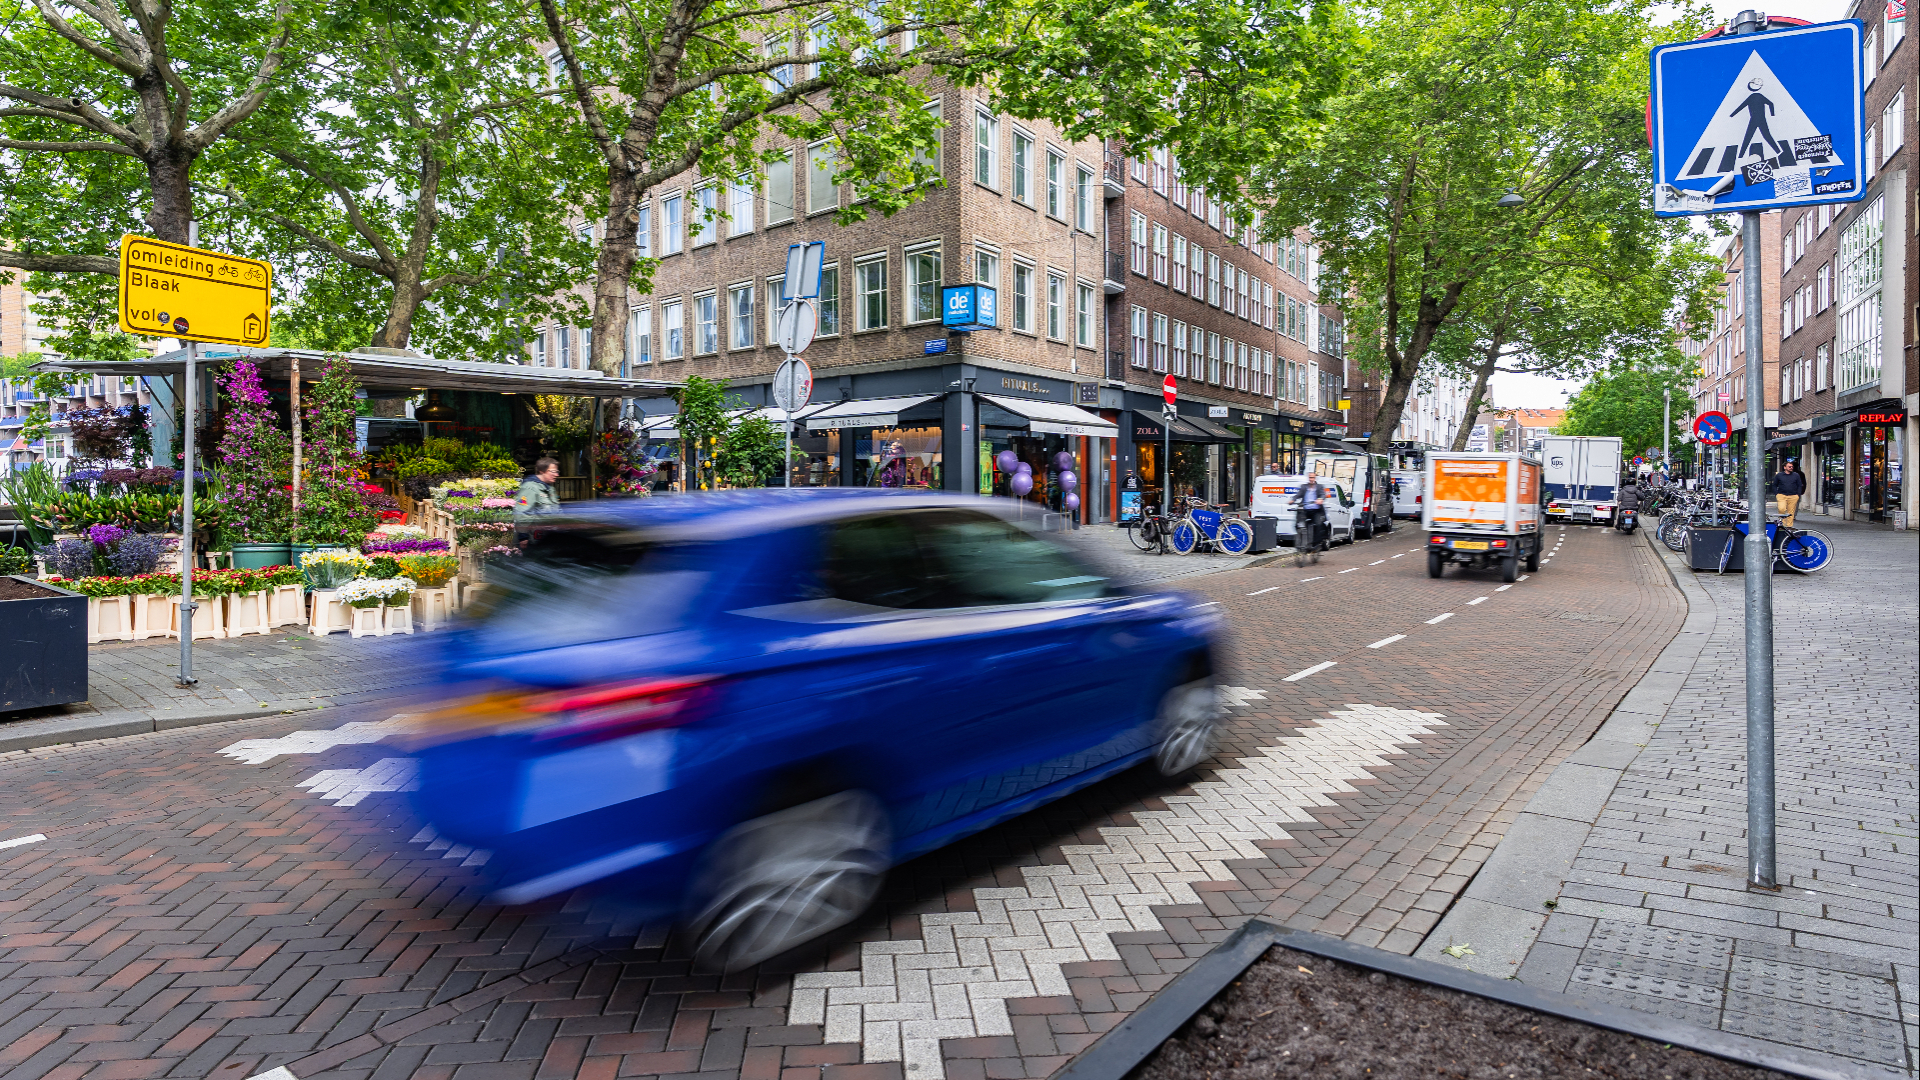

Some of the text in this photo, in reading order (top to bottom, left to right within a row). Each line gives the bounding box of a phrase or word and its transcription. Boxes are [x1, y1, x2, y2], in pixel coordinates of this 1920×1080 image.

[131, 249, 214, 277] omleiding
[131, 272, 180, 292] Blaak
[949, 291, 969, 309] de
[130, 308, 165, 326] vol
[248, 322, 258, 336] F
[1859, 413, 1904, 423] REPLAY
[1136, 427, 1159, 435] ZOLA
